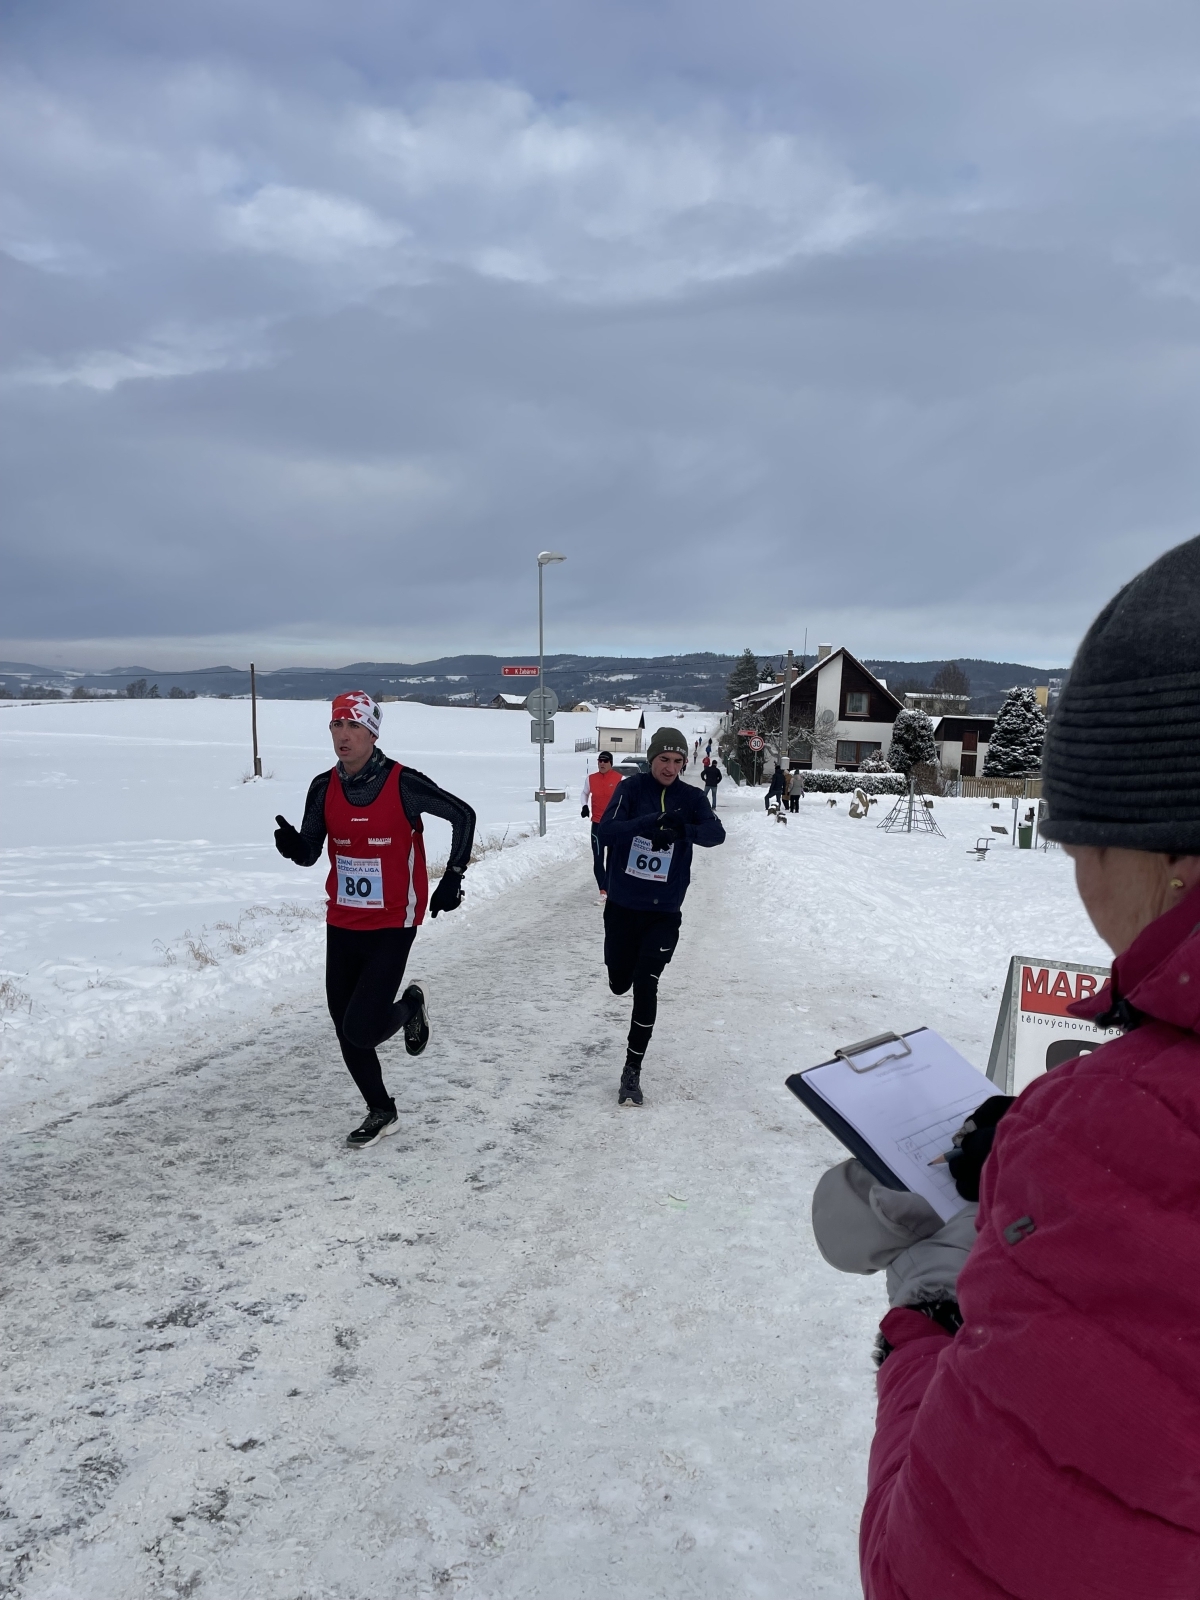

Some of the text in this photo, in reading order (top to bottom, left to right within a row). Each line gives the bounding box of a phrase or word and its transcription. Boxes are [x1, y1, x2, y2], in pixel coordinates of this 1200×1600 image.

[337, 857, 353, 866] ZIMNÍ
[636, 854, 662, 872] 60
[345, 876, 372, 898] 80
